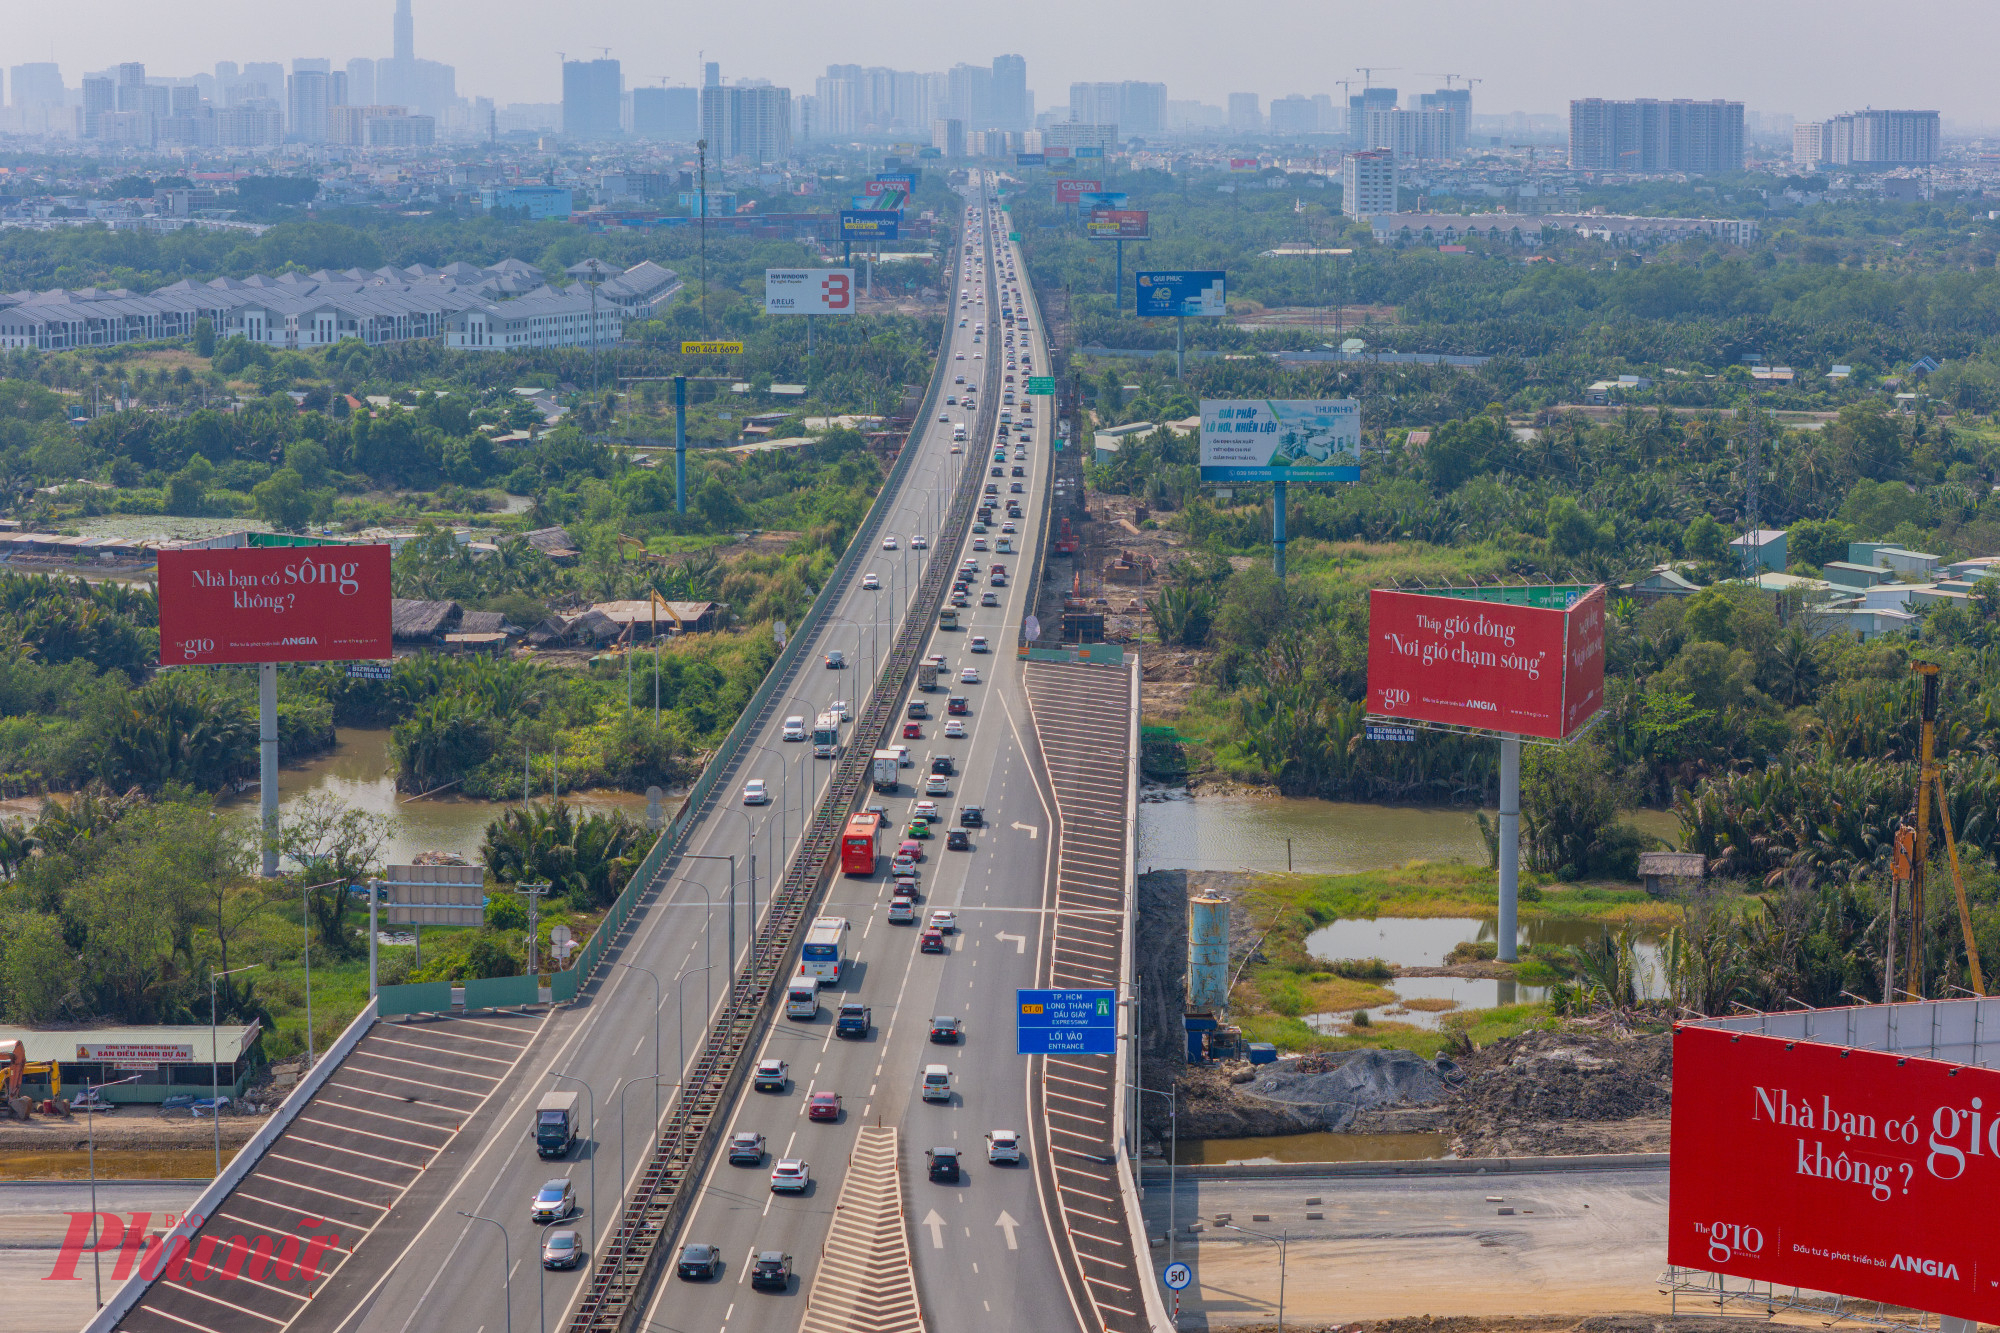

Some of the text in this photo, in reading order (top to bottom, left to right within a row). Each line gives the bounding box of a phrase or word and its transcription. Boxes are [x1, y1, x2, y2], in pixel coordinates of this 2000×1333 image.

[1062, 182, 1096, 190] CASTA
[1219, 406, 1257, 419] GIẢI PHÁP
[1235, 420, 1258, 432] NHIÊN
[1260, 421, 1277, 435] LIỆU
[192, 557, 359, 596] Nhà bạn có sông
[234, 591, 295, 613] không ?
[1417, 614, 1515, 647] Tháp gió đông
[281, 637, 318, 645] ANGIA
[1423, 642, 1448, 666] gió
[1451, 641, 1496, 668] chạm
[1466, 699, 1497, 711] ANGIA
[1049, 1031, 1082, 1040] LỐI VÀO
[1751, 1086, 1815, 1129] Nhà
[1821, 1094, 1877, 1141] bạn
[1884, 1115, 1918, 1145] có
[1796, 1138, 1913, 1201] không ?
[1694, 1222, 1711, 1234] The
[1793, 1244, 1960, 1281] Đầu tư & phát triển bởi ANGIA
[1172, 1271, 1184, 1281] 50
